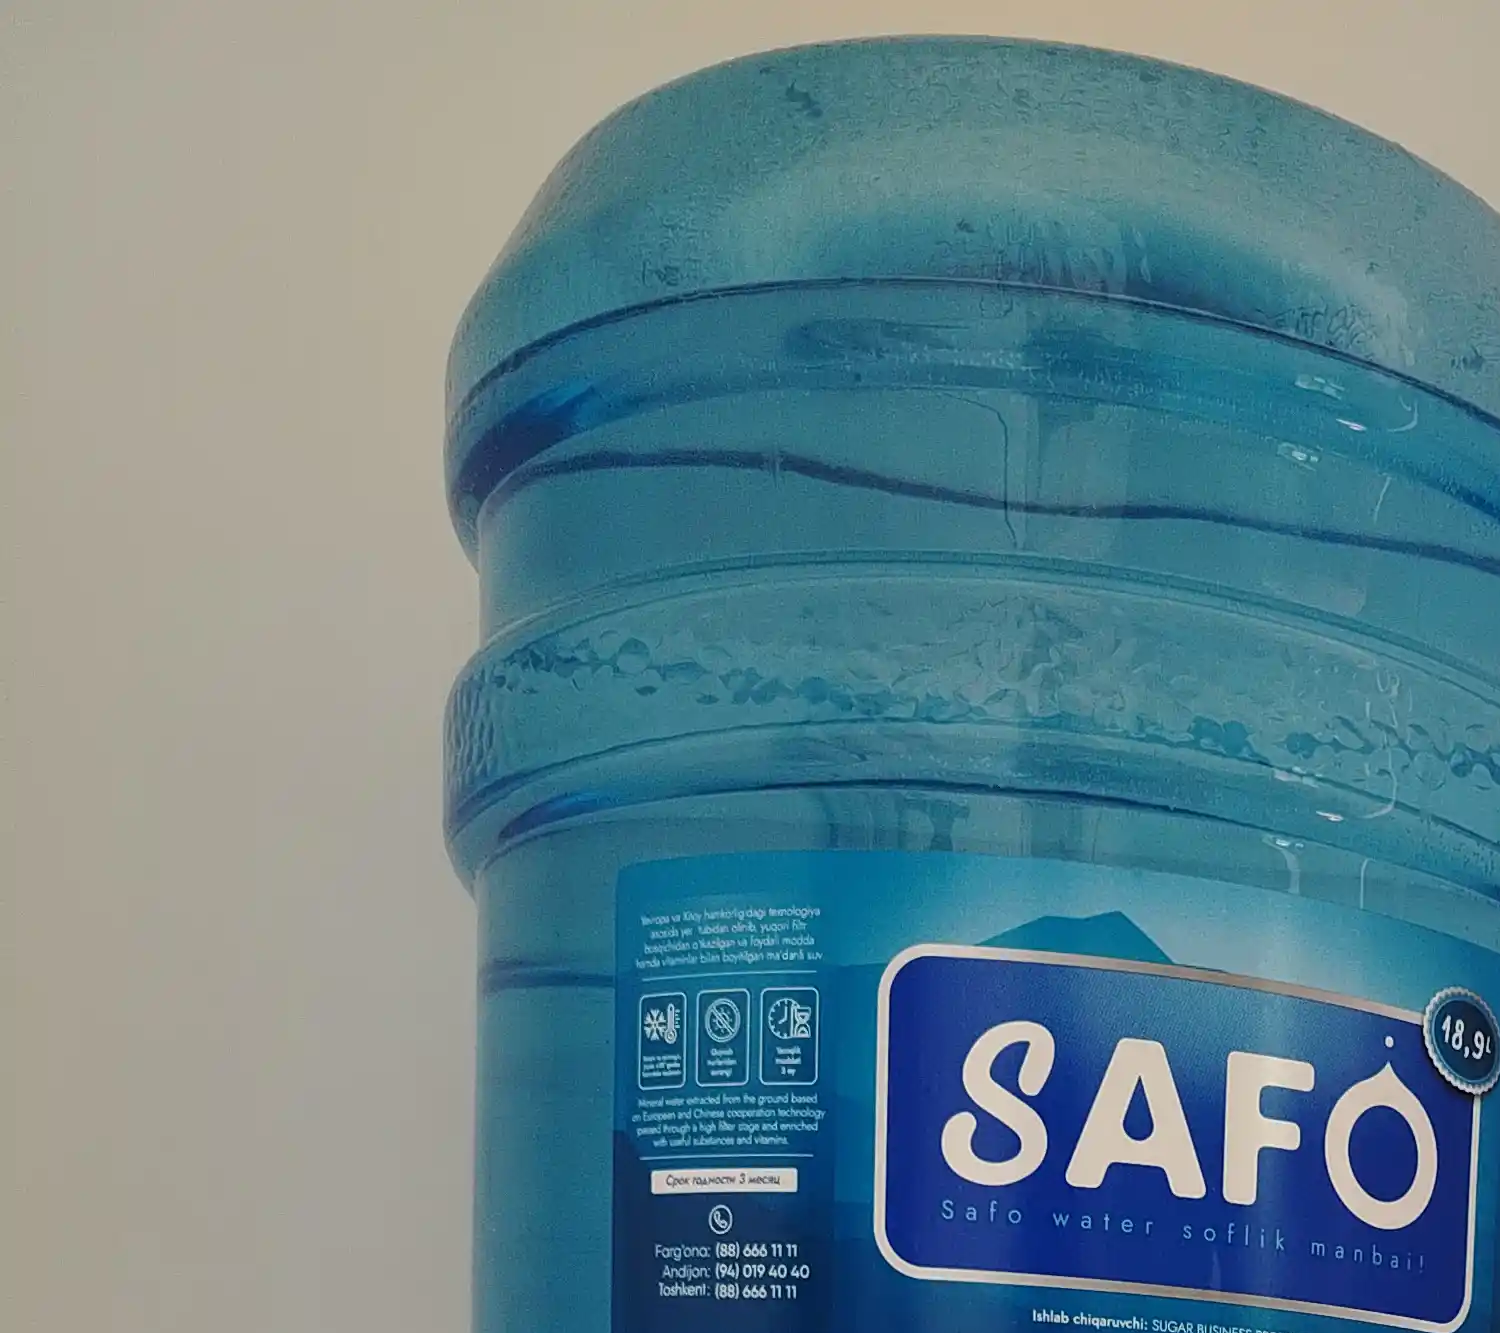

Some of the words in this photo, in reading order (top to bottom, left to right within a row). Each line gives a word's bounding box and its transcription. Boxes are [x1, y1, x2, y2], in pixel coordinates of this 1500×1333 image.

[758, 1092, 789, 1106] ground
[791, 1092, 818, 1104] based
[941, 1020, 1438, 1229] SAFO
[665, 1173, 689, 1188] Срок
[739, 1173, 745, 1185] 3
[941, 1200, 1022, 1225] Safo
[1053, 1212, 1154, 1236] water
[1183, 1223, 1285, 1251] soflik
[1310, 1239, 1425, 1273] manbai!
[715, 1241, 740, 1259] (88)
[742, 1243, 768, 1257] 666
[771, 1243, 783, 1257] 11
[786, 1243, 798, 1257] 11
[662, 1264, 711, 1281] Andijon:
[715, 1262, 740, 1279] (94)
[742, 1264, 766, 1278] 019
[768, 1264, 787, 1278] 40
[791, 1264, 810, 1279] 40
[714, 1282, 740, 1299] (88)
[742, 1284, 767, 1299] 666
[770, 1284, 782, 1299] 11
[785, 1285, 797, 1299] 11
[1032, 1308, 1069, 1324] Ishlab
[1073, 1313, 1148, 1331] chiqaruvchi:
